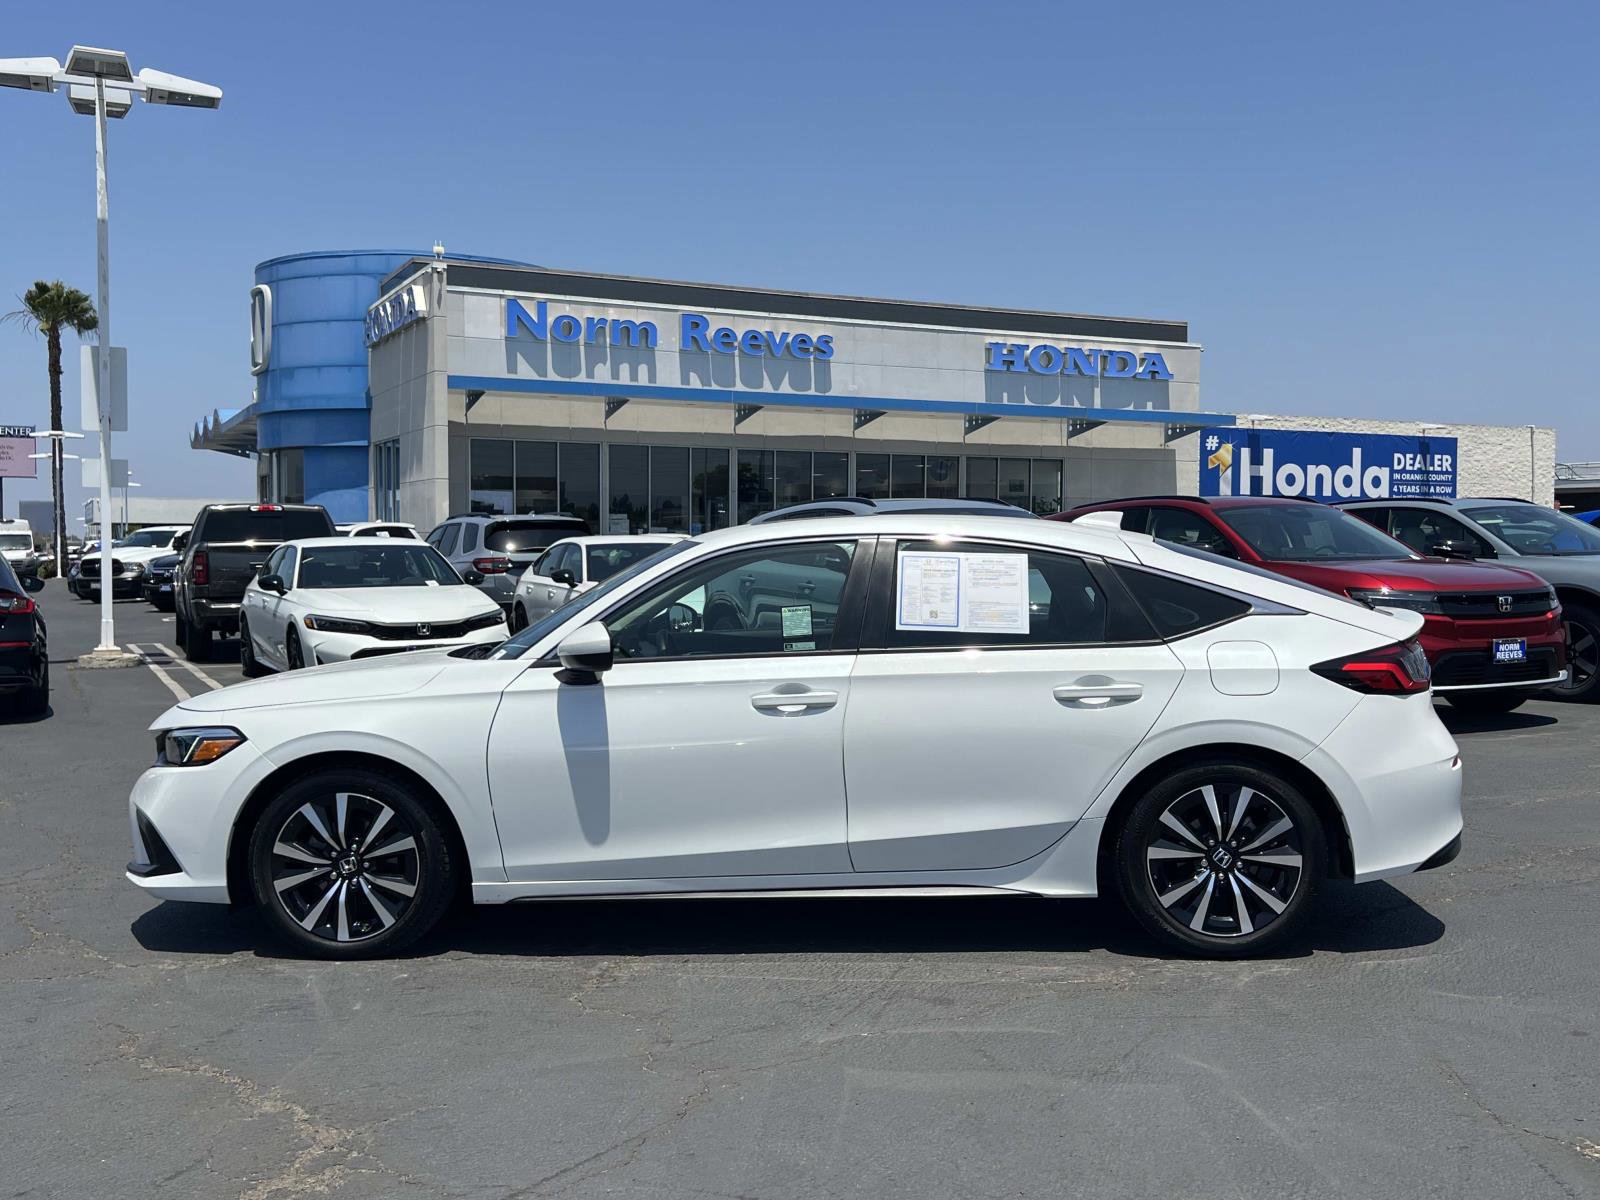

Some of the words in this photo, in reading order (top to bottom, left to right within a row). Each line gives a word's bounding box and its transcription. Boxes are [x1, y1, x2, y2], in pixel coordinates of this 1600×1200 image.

[362, 285, 427, 347] HONDA
[506, 298, 658, 349] Norm
[680, 313, 834, 361] Reeves
[985, 341, 1175, 380] HONDA
[1393, 452, 1453, 472] DEALER
[1240, 447, 1390, 499] Honda
[1402, 473, 1427, 481] ORANGE
[1429, 474, 1453, 482] COUNTY
[1393, 485, 1398, 493] 4
[1399, 485, 1420, 493] YEARS
[1421, 485, 1428, 493] IN
[1436, 486, 1453, 494] ROW
[1496, 650, 1523, 660] REEVES
[1499, 643, 1520, 652] NORM
